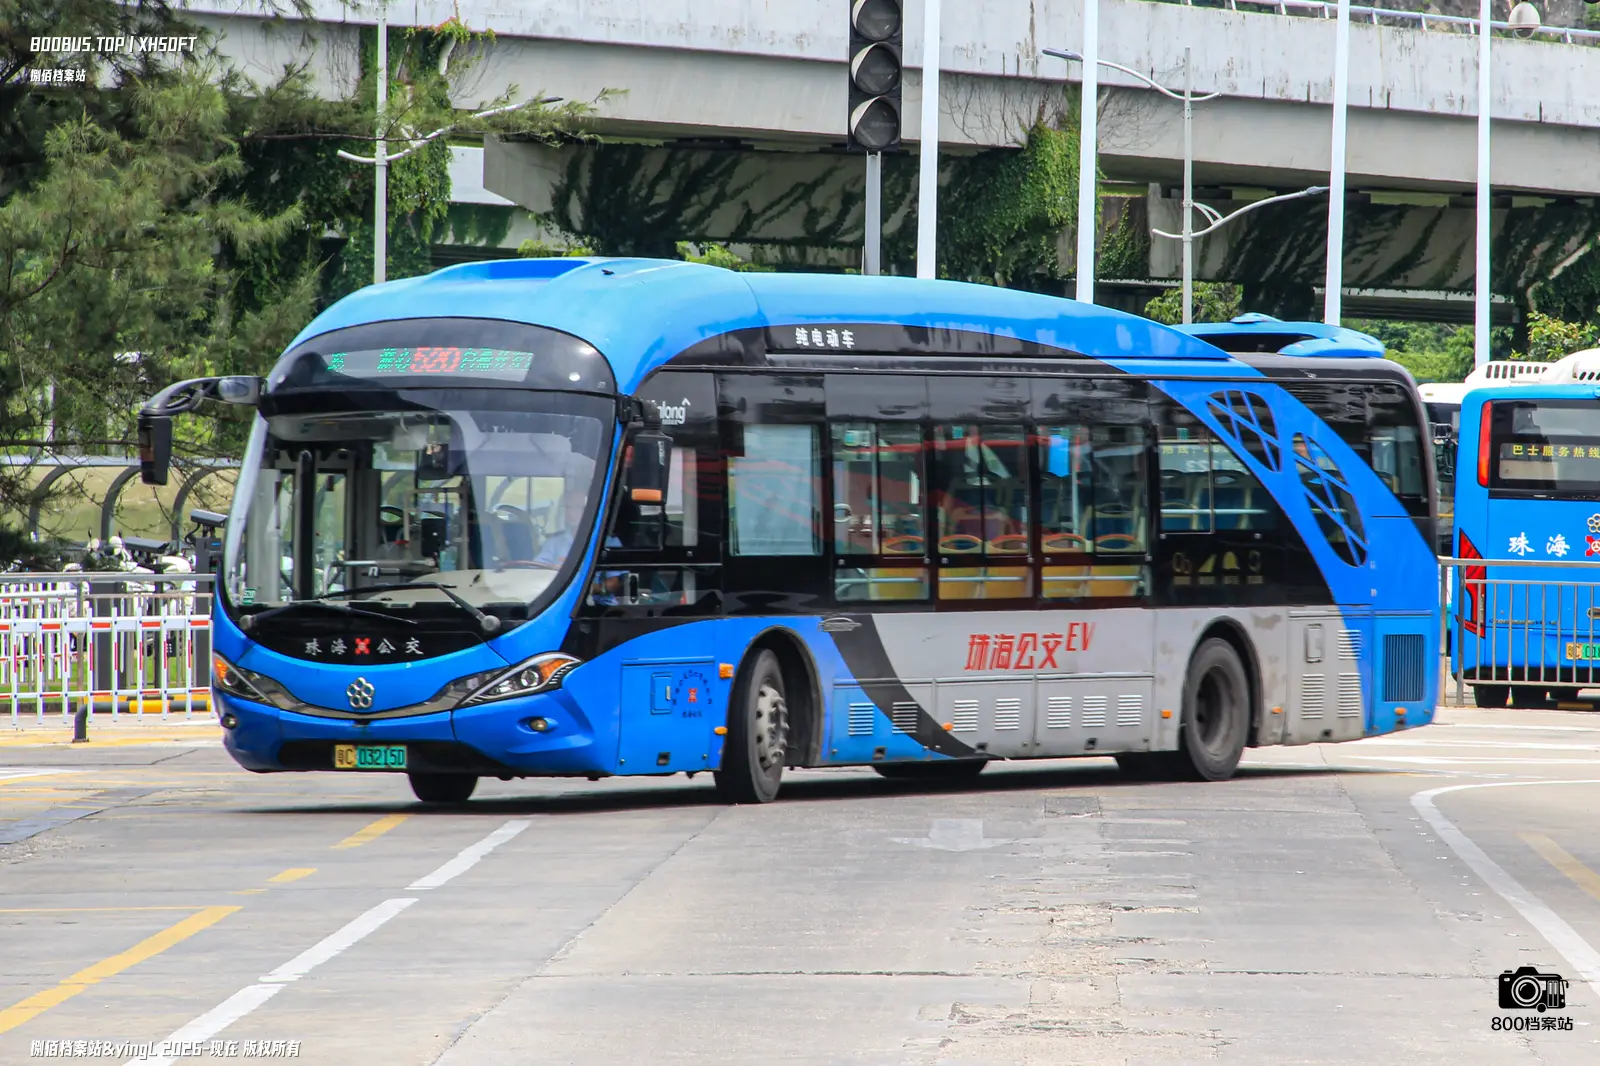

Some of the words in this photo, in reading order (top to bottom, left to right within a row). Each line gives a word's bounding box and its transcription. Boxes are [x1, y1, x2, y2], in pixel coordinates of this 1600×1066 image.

[795, 327, 855, 349] 纯电动车
[1512, 444, 1600, 459] 巴士服务热线
[1507, 531, 1571, 557] 珠海
[305, 638, 348, 656] 珠海
[377, 637, 424, 655] 公交
[964, 632, 1063, 671] 珠海公交
[1065, 621, 1097, 652] EV
